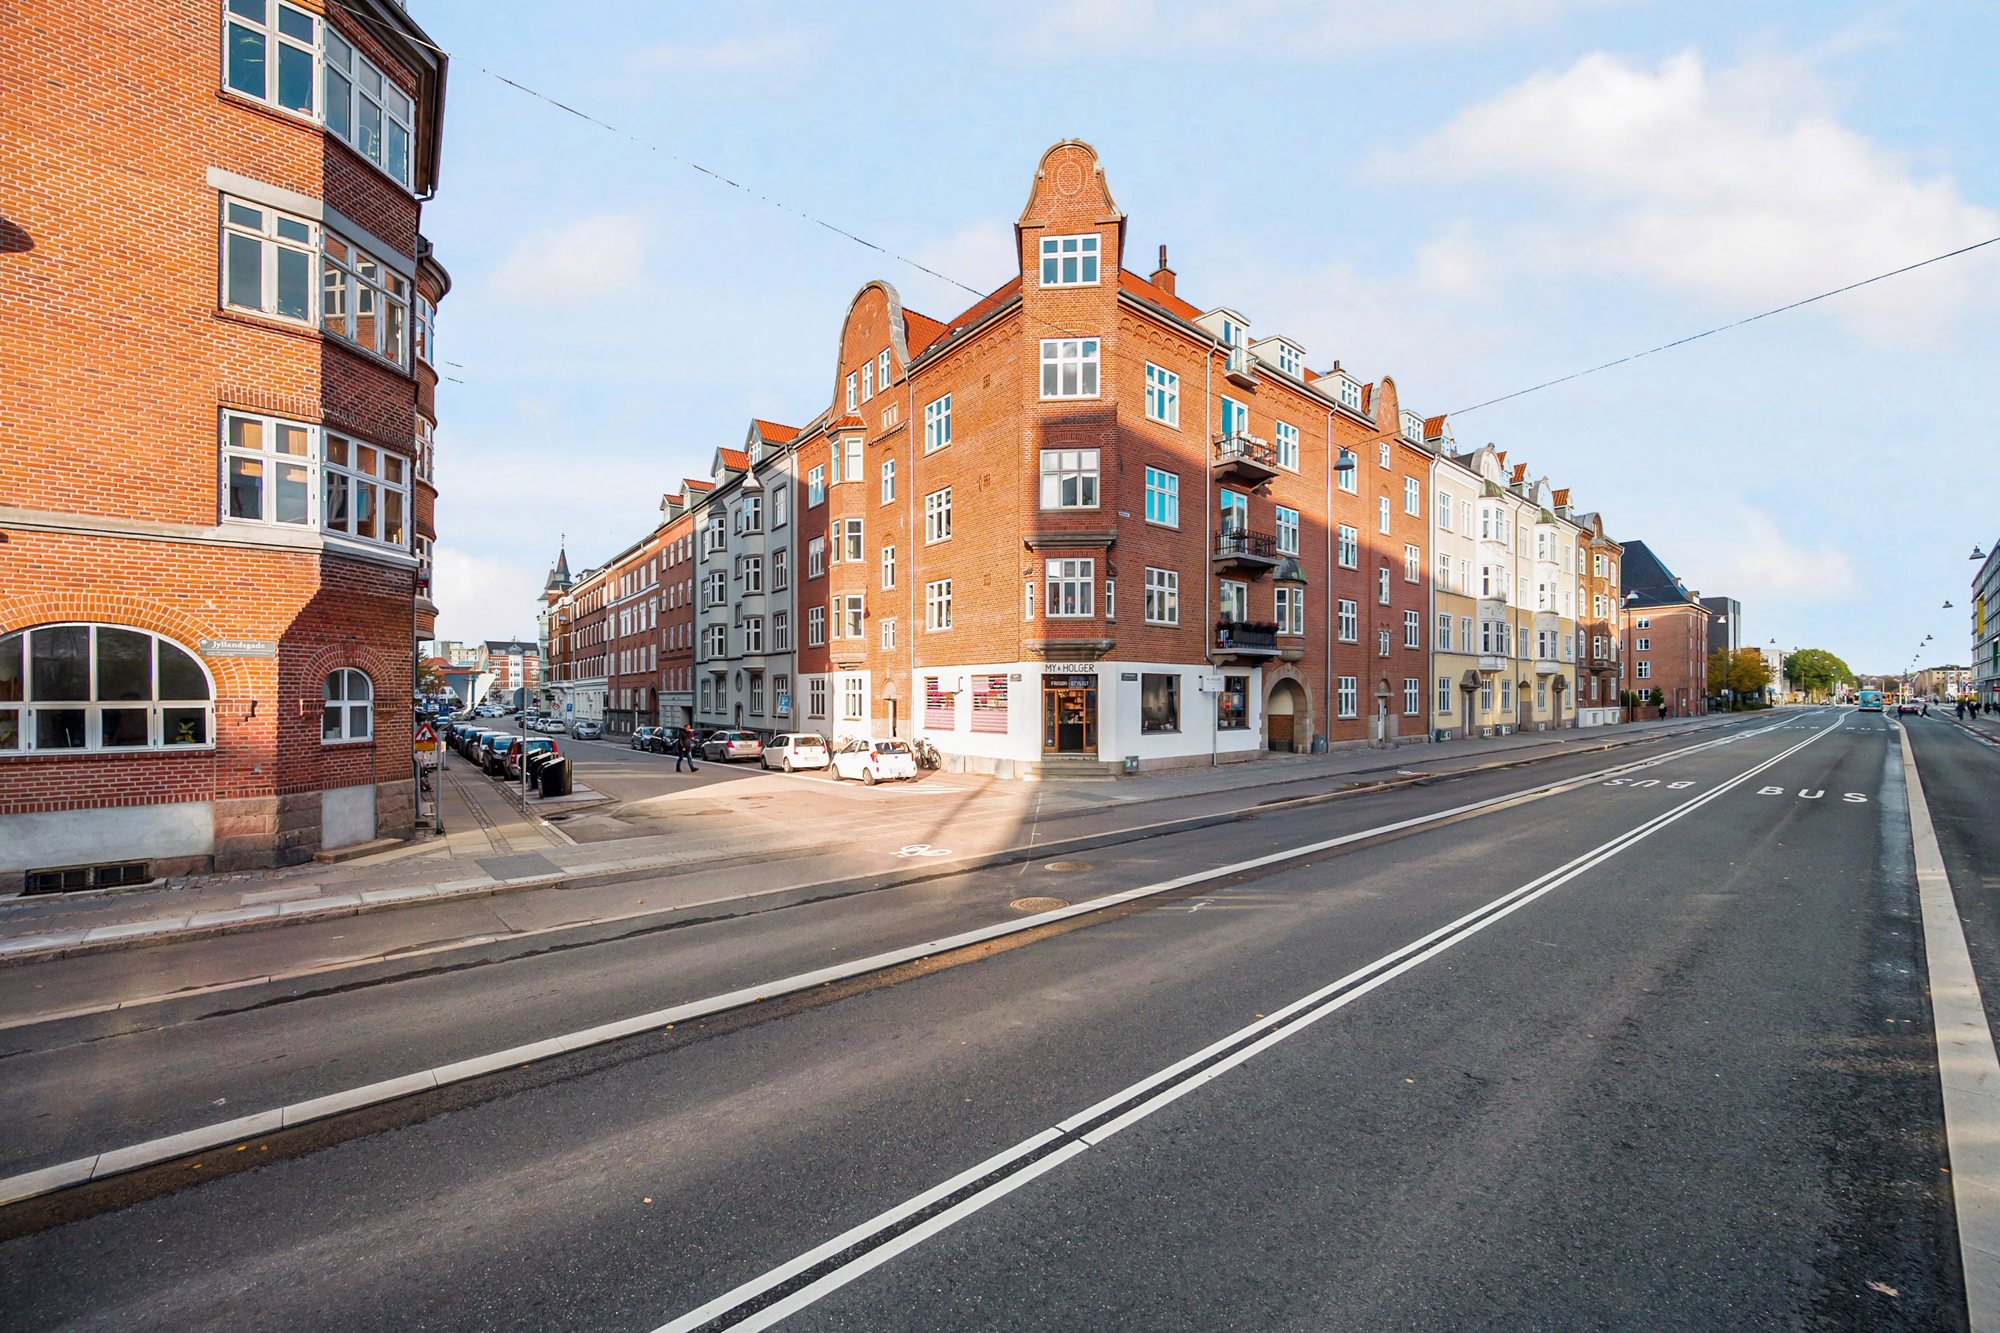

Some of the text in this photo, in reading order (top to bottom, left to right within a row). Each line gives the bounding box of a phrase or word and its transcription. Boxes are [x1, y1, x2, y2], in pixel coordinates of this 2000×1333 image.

[212, 641, 266, 649] Jyllandsgade
[1045, 663, 1057, 673] MY
[1062, 663, 1095, 673] HOLGER
[1602, 778, 1697, 789] BUS
[1756, 785, 1870, 803] BUS
